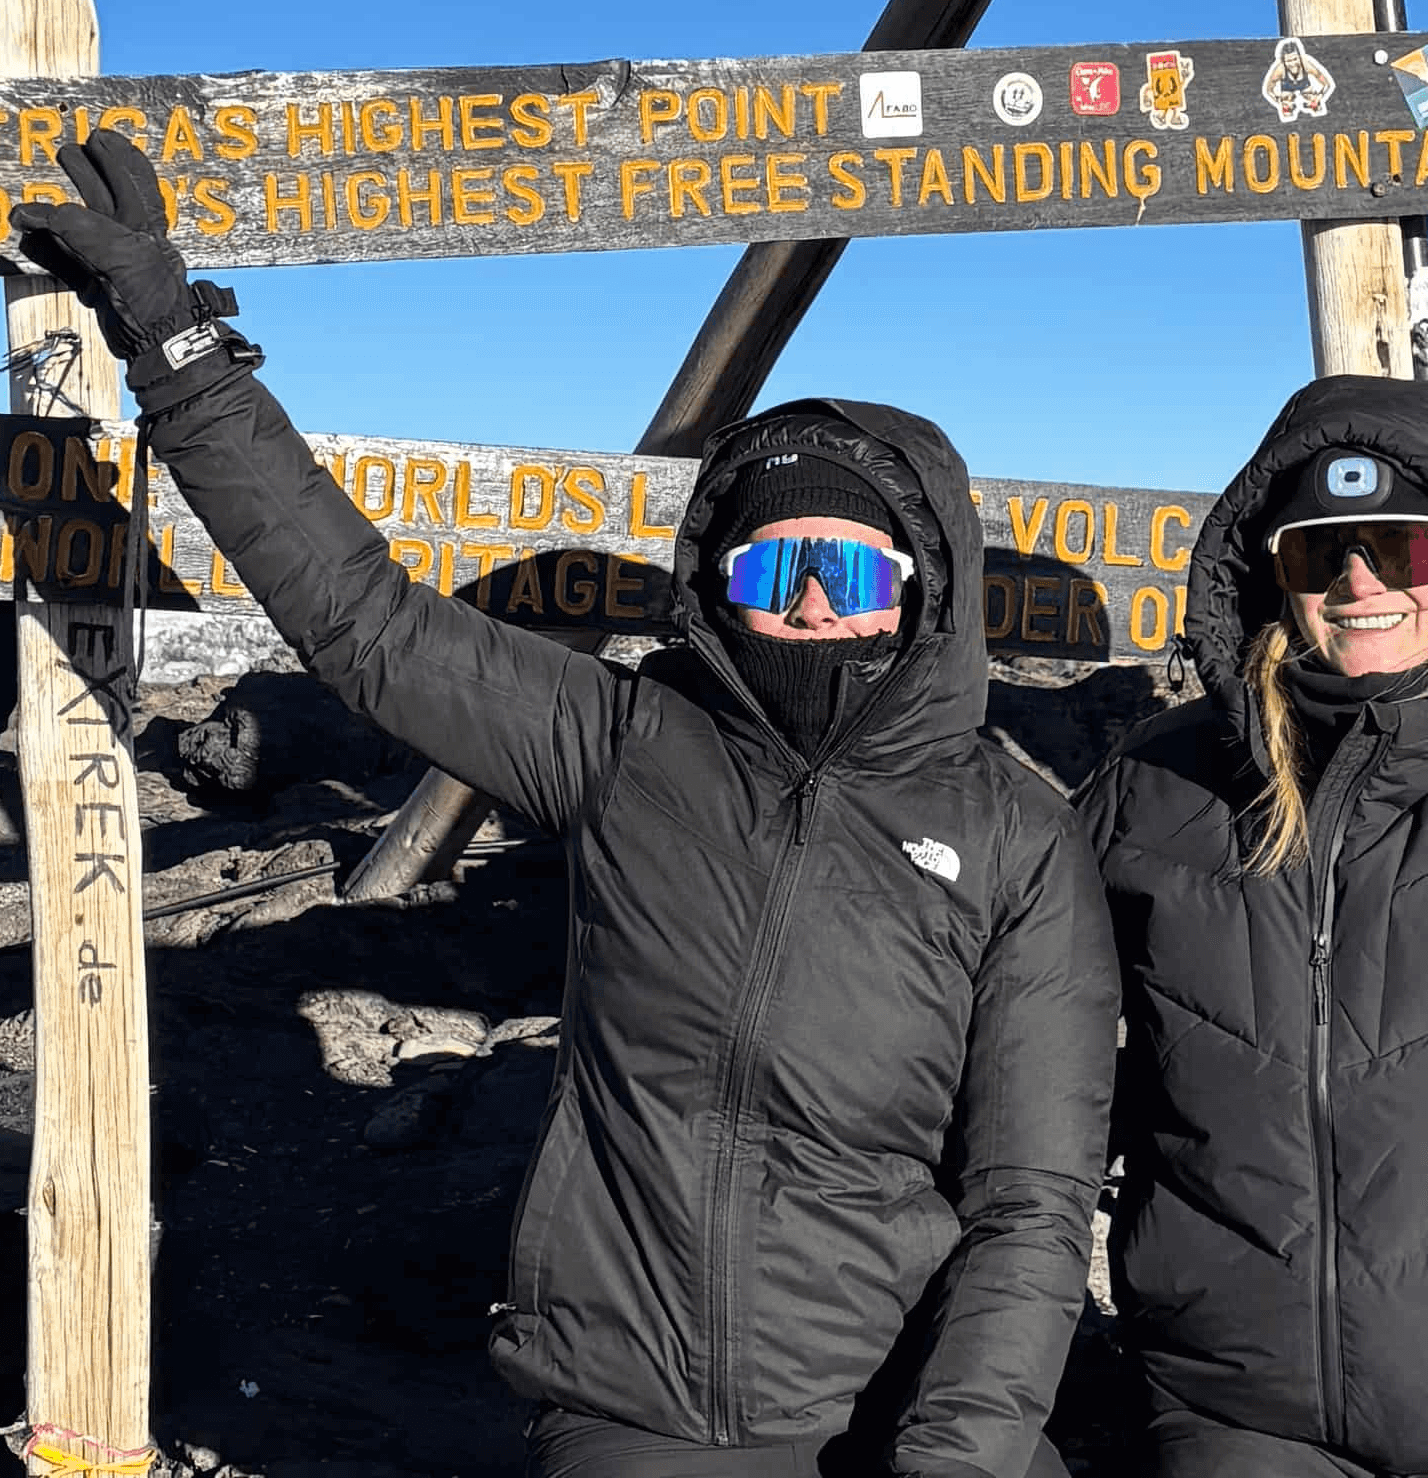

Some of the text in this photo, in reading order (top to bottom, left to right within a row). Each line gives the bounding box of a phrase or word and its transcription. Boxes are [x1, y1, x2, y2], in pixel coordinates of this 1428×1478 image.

[285, 92, 599, 157] HIGHEST
[639, 82, 841, 143] POINT
[264, 161, 594, 233] HIGHEST
[618, 154, 807, 220] FREE
[829, 139, 1160, 211] STANDING
[332, 453, 606, 535] ORLD'S
[388, 538, 650, 619] RITAGE
